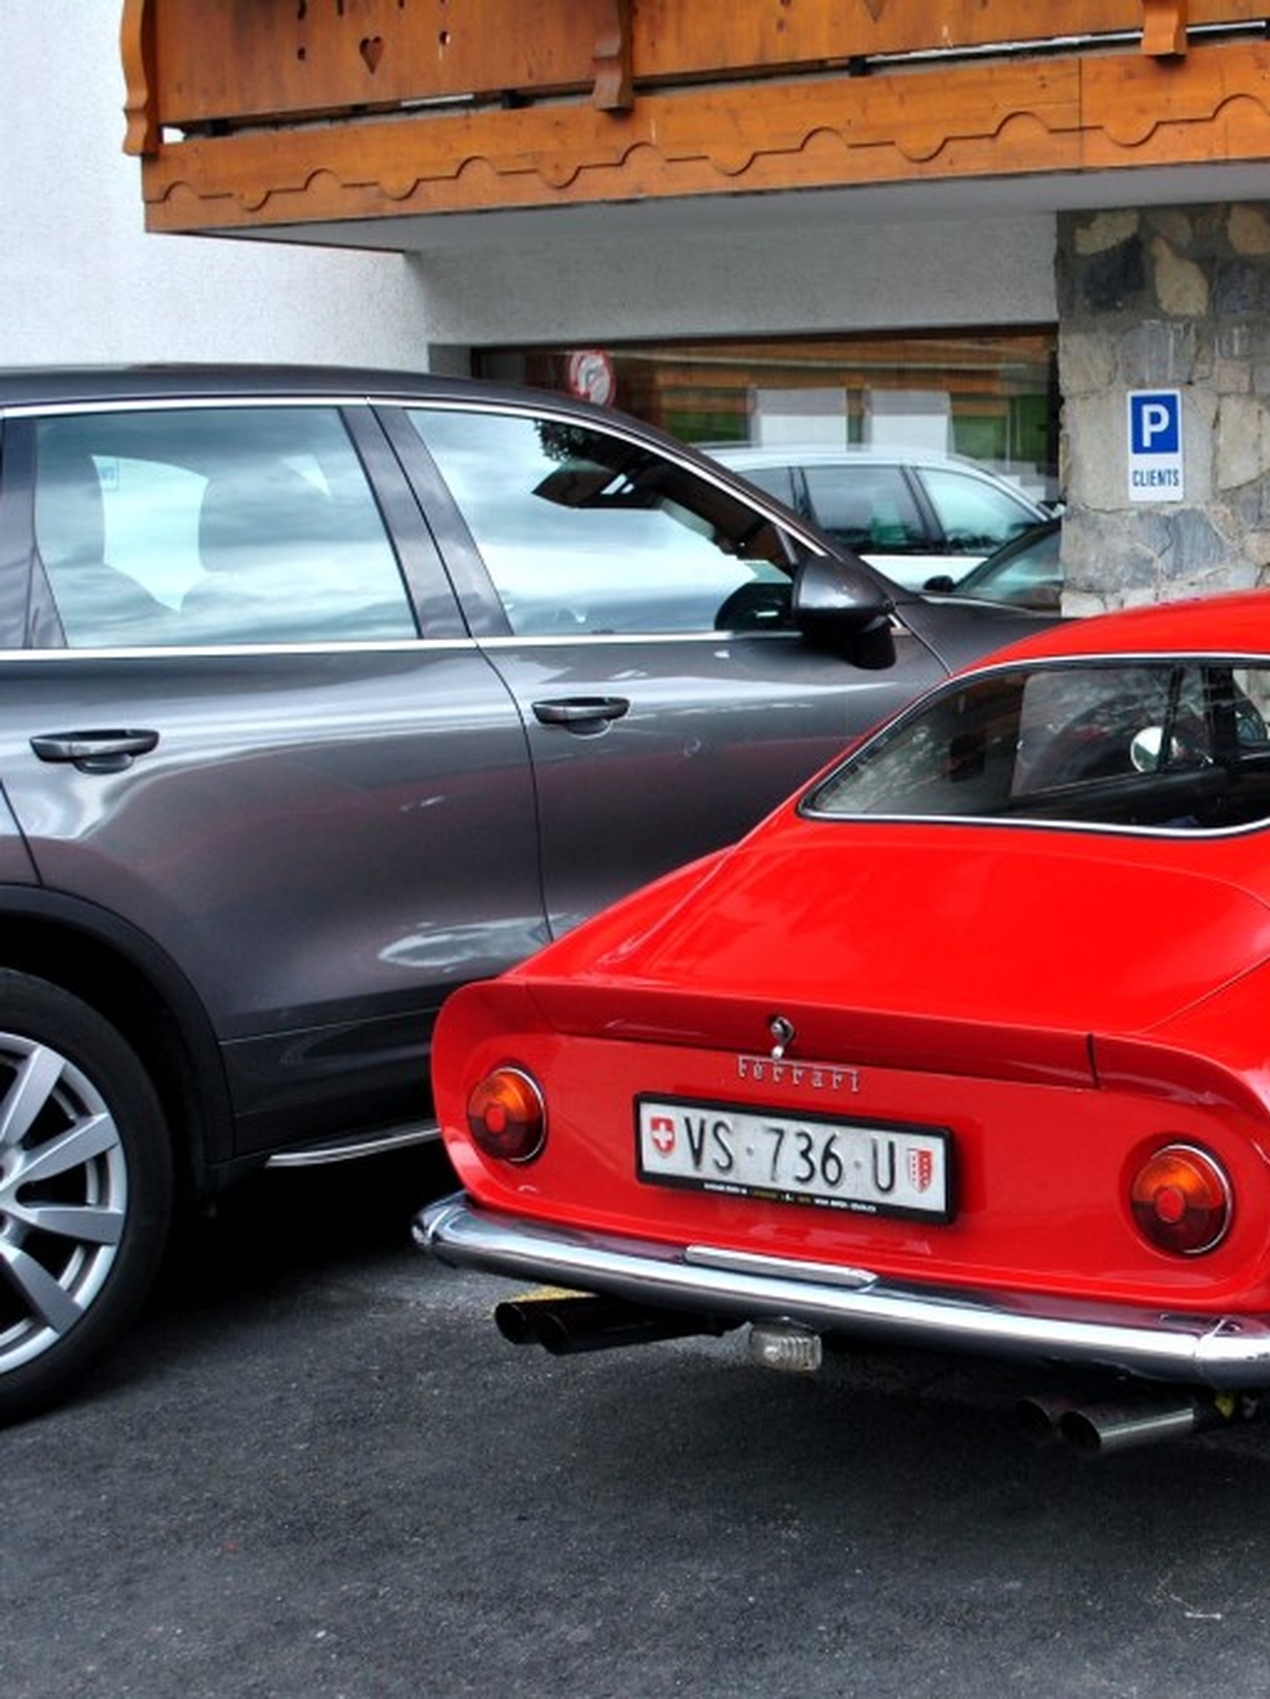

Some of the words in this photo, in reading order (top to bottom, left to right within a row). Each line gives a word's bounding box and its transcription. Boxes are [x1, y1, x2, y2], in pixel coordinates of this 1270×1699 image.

[1142, 404, 1170, 447] P
[1133, 469, 1180, 487] CLIENTS
[737, 1056, 860, 1092] Ferrari
[763, 1128, 844, 1187] 736
